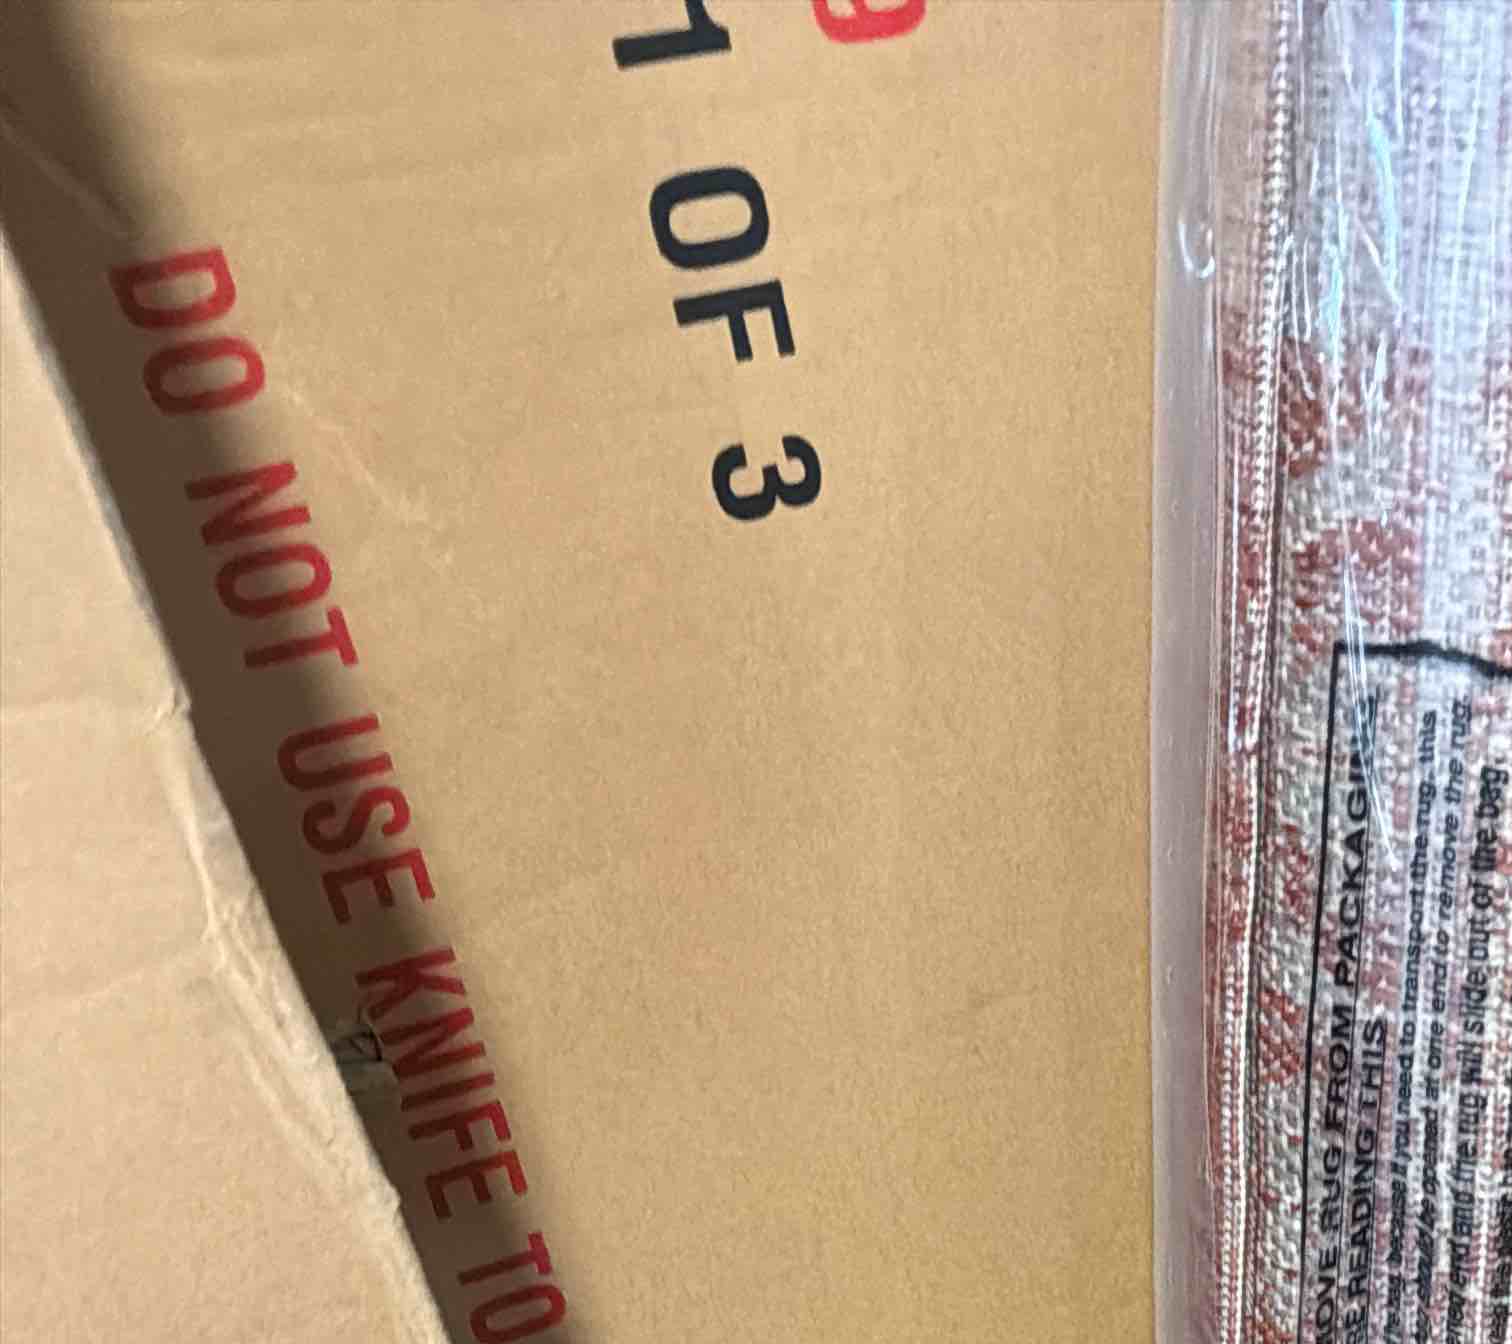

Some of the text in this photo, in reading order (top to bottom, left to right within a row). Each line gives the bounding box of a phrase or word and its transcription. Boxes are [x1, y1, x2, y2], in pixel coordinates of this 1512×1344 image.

[648, 165, 796, 364] OF
[109, 246, 266, 417] DO
[711, 435, 822, 522] 3
[185, 461, 360, 671] NOT
[1419, 711, 1437, 763] this
[1443, 759, 1464, 804] the
[277, 712, 436, 925] USE
[1410, 836, 1430, 881] the
[1434, 814, 1460, 919] remove
[1469, 830, 1497, 871] the
[1467, 878, 1491, 909] of
[1401, 886, 1427, 1011] transport
[1431, 929, 1449, 954] to
[1464, 918, 1490, 961] out
[1427, 962, 1447, 1014] end
[1462, 970, 1487, 1034] slide
[1360, 1018, 1387, 1108] THIS
[1398, 1023, 1416, 1044] to
[1427, 1023, 1444, 1069] one
[354, 945, 530, 1223] KNIFE
[1323, 1005, 1351, 1131] FROM
[1391, 1056, 1415, 1115] need
[1390, 1121, 1411, 1160] you
[1460, 1093, 1487, 1133] rug
[1319, 1144, 1342, 1235] RUG
[1348, 1128, 1376, 1298] READING
